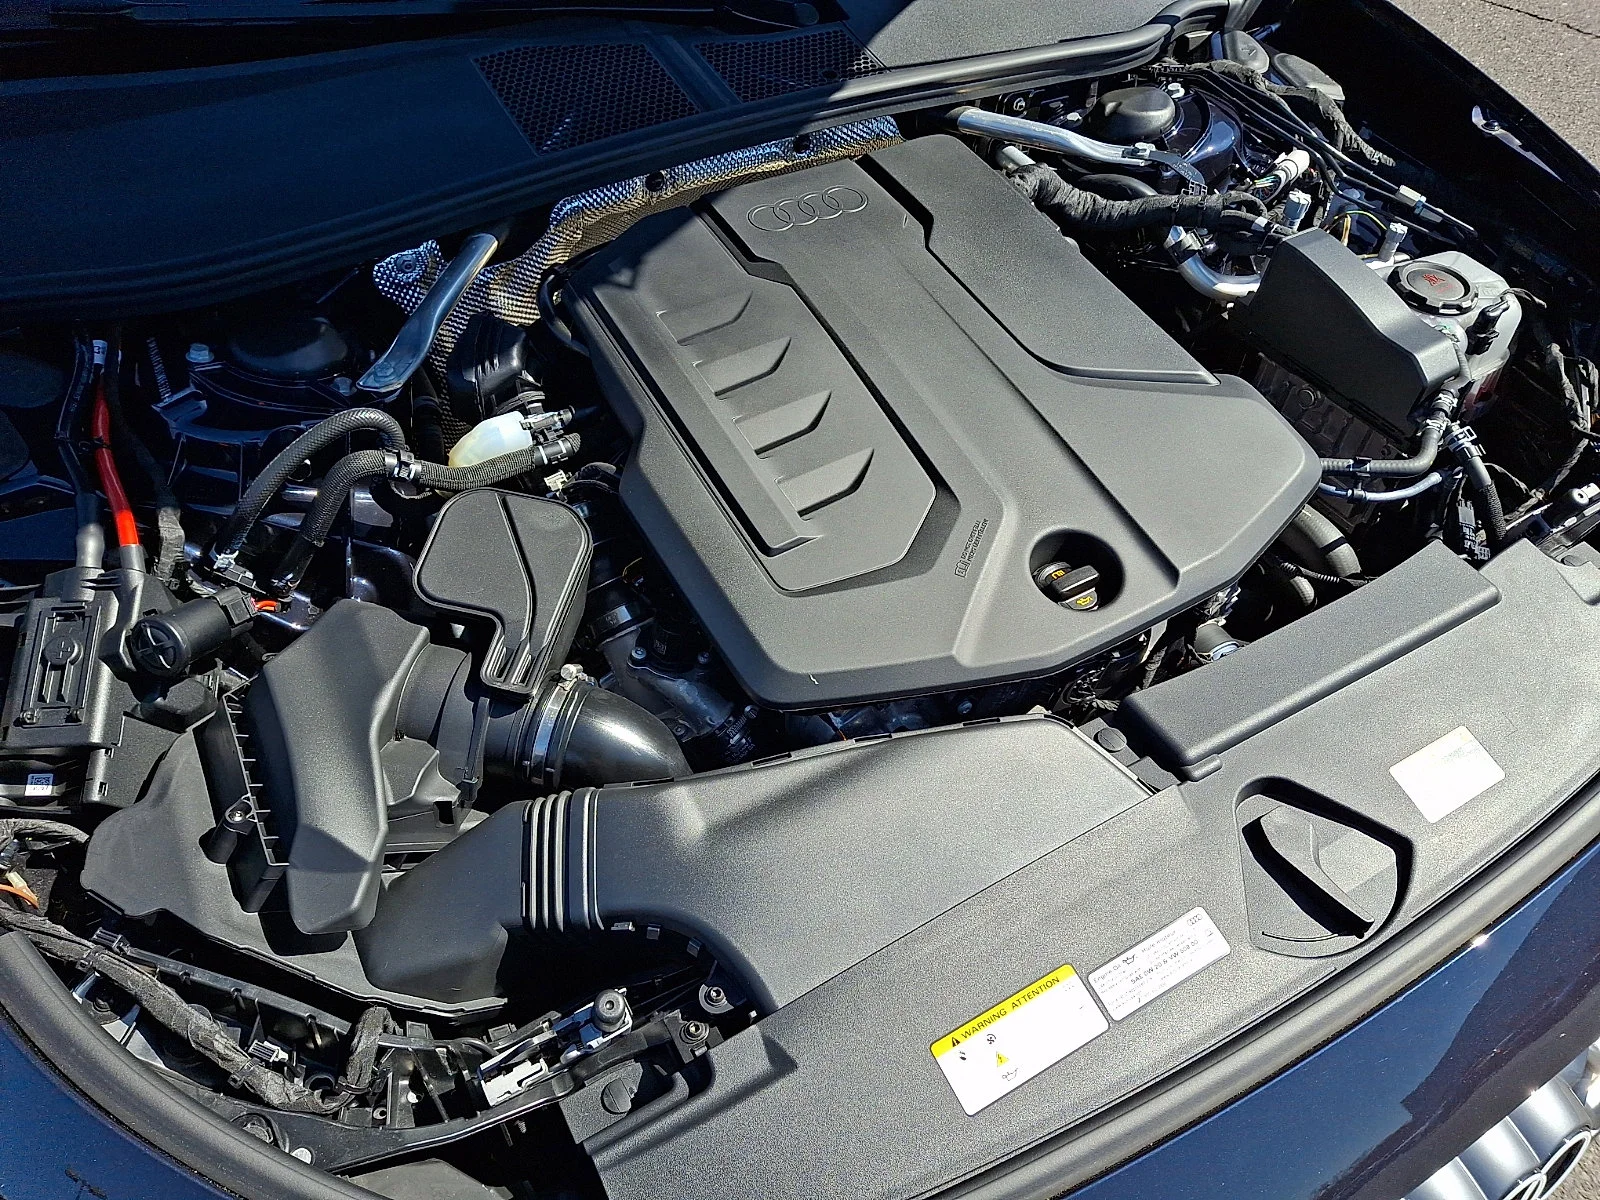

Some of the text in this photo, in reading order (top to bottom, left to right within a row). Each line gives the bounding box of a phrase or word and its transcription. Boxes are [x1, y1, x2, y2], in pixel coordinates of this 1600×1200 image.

[1131, 973, 1143, 984] SAE
[1169, 951, 1179, 960] VW
[961, 976, 1060, 1040] WARNING ATTENTION
